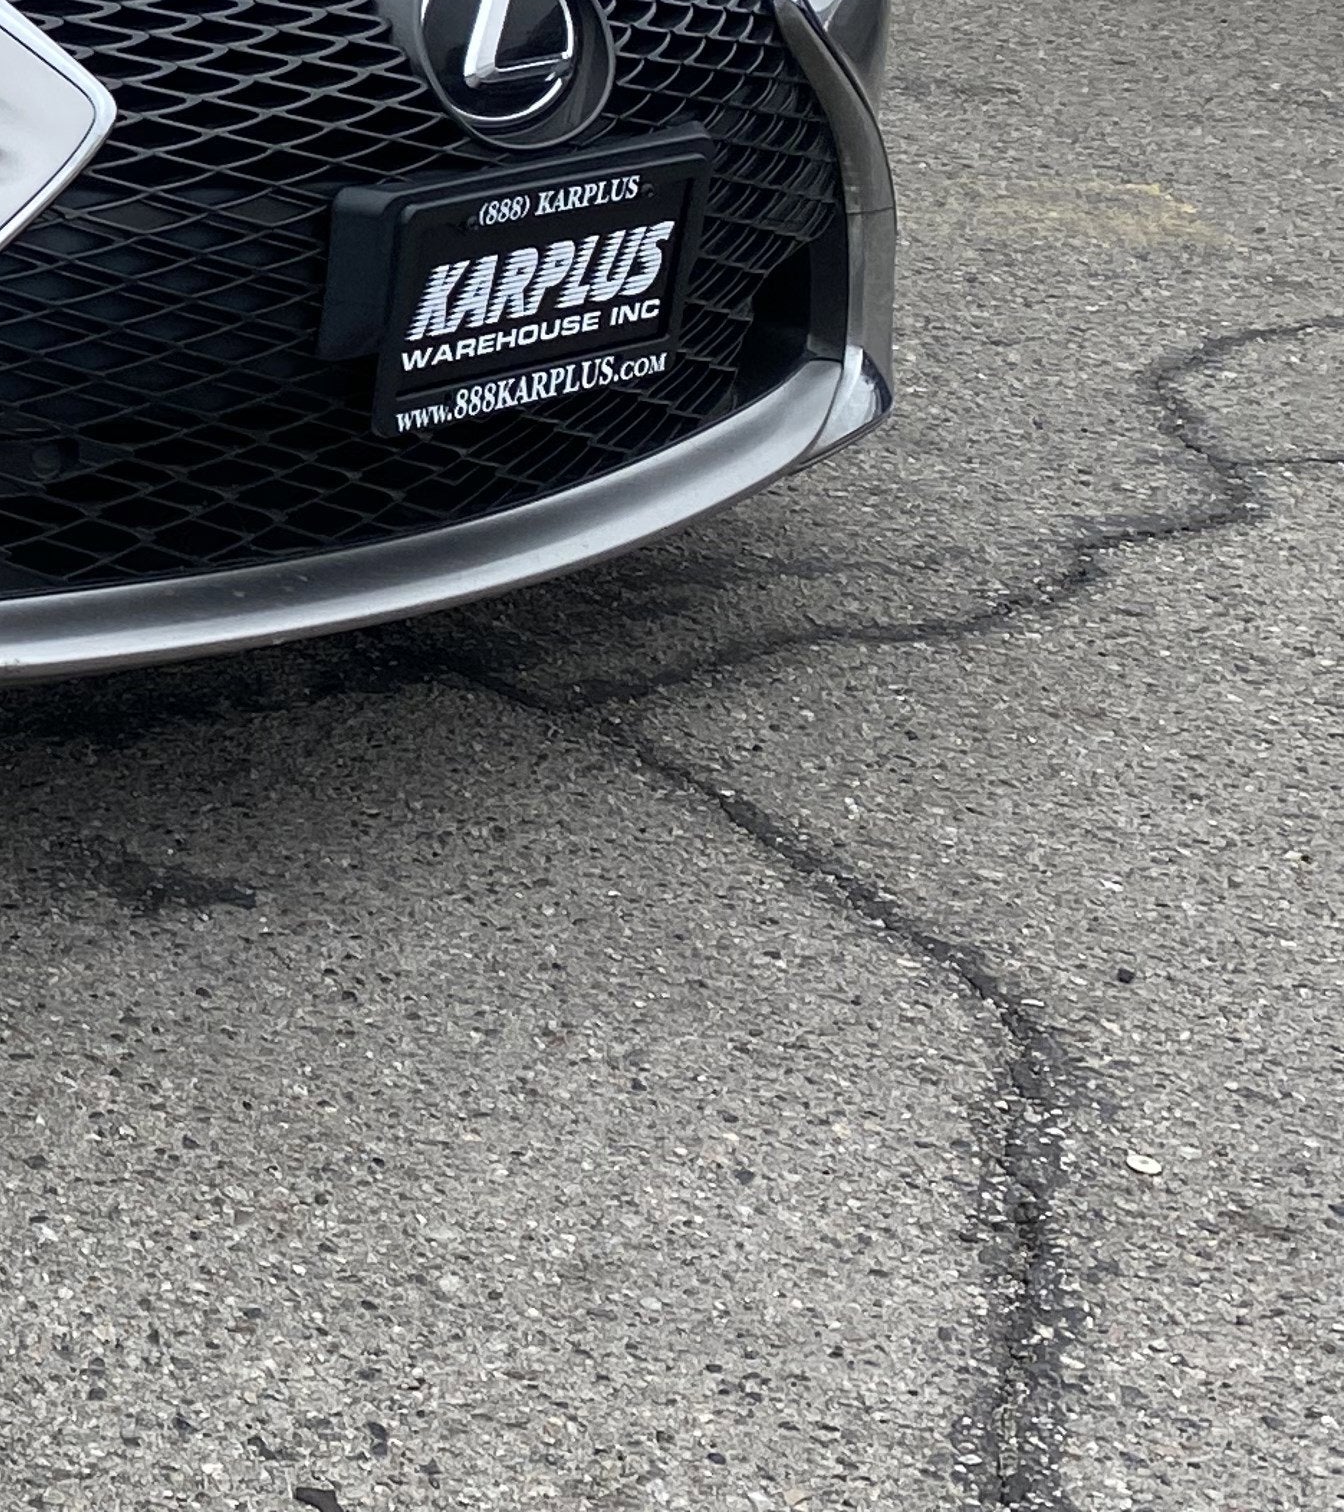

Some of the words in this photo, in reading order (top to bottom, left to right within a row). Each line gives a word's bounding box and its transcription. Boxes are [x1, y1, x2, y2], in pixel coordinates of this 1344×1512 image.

[478, 195, 531, 226] (888)
[534, 175, 641, 217] KARPLUS
[404, 221, 675, 341] KARPLUS
[401, 310, 602, 372] WAREHOUSE
[610, 299, 661, 326] INC
